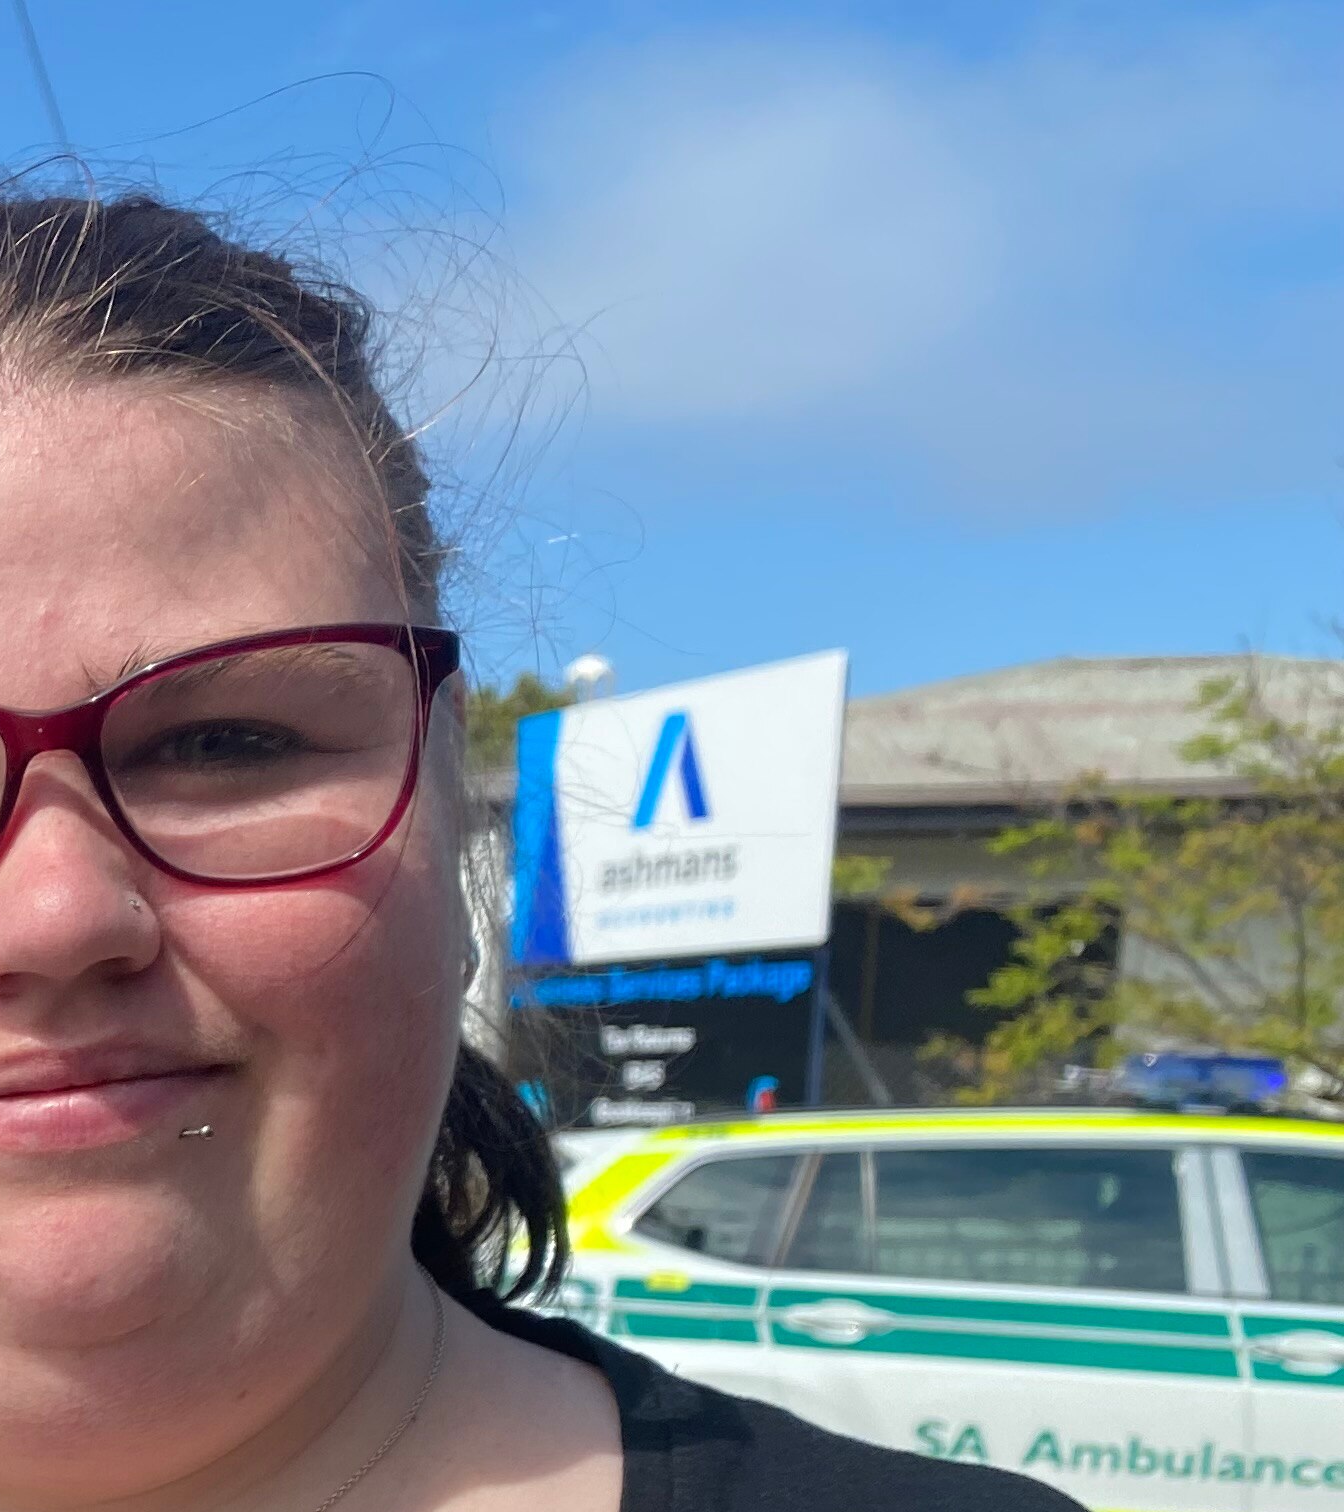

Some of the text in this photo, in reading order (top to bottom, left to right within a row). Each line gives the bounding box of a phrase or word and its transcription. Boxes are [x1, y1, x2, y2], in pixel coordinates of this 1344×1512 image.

[600, 845, 739, 891] ashmans
[915, 1420, 1344, 1488] SA Ambulance
